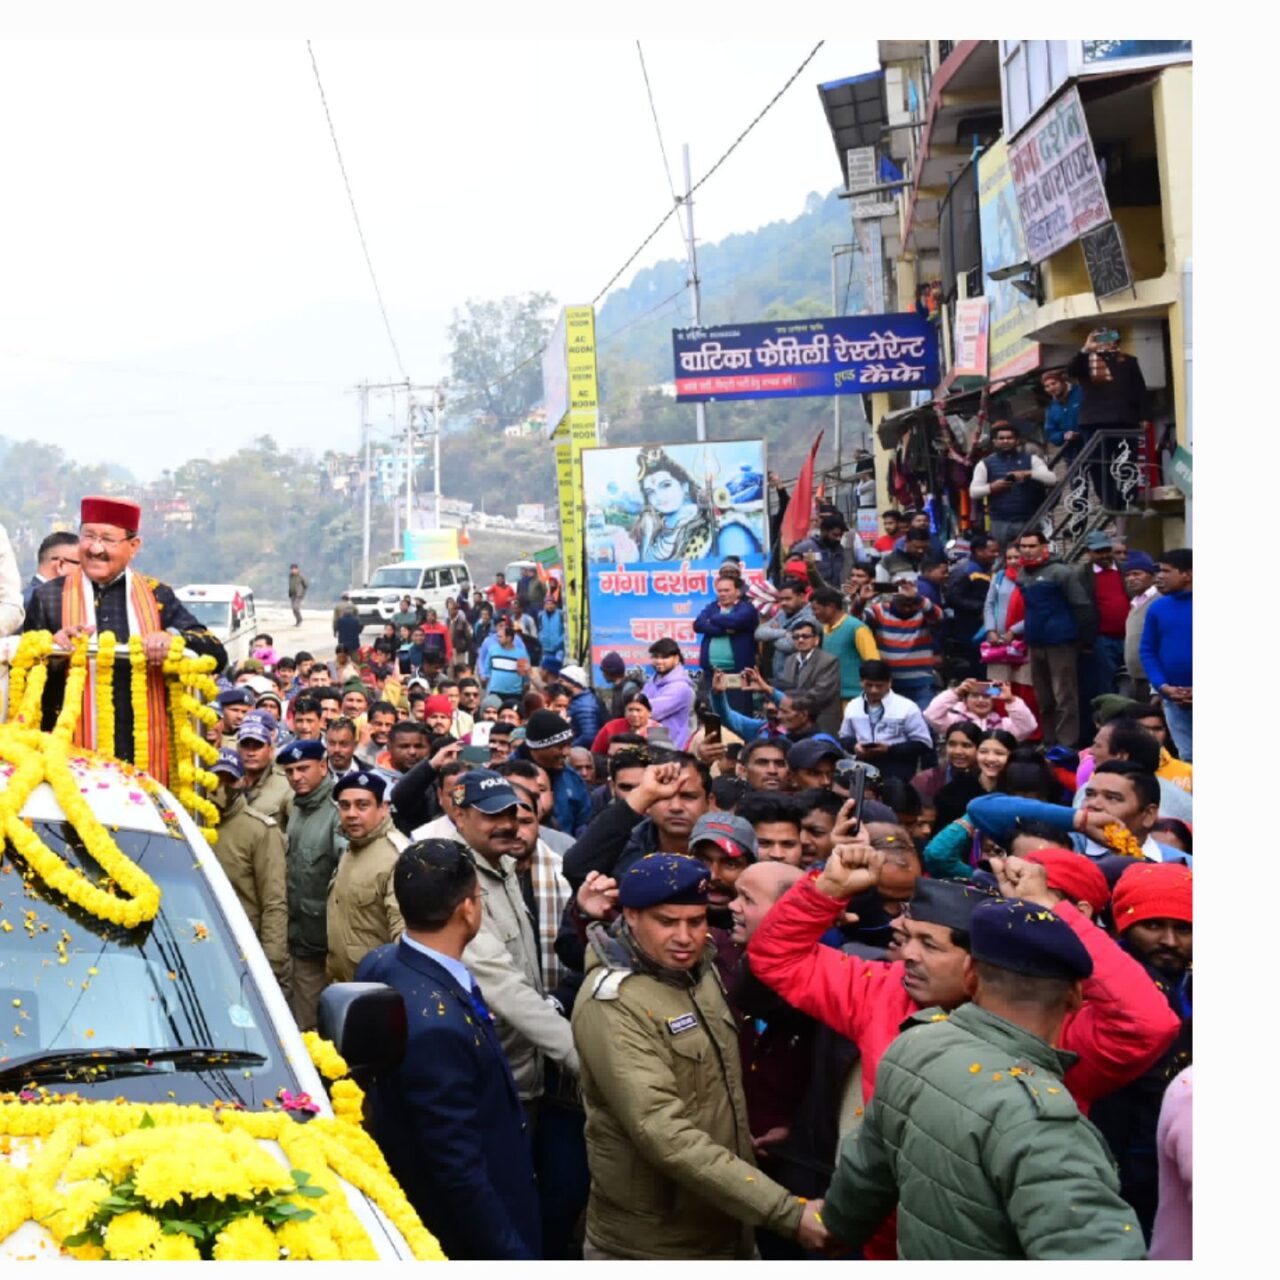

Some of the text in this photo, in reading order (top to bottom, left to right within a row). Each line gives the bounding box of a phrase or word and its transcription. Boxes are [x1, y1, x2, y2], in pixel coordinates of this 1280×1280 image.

[680, 341, 752, 371] वाटिका
[833, 329, 926, 361] रेस्टोरेन्ट
[599, 564, 648, 595] गंगा
[652, 561, 709, 595] दर्शन
